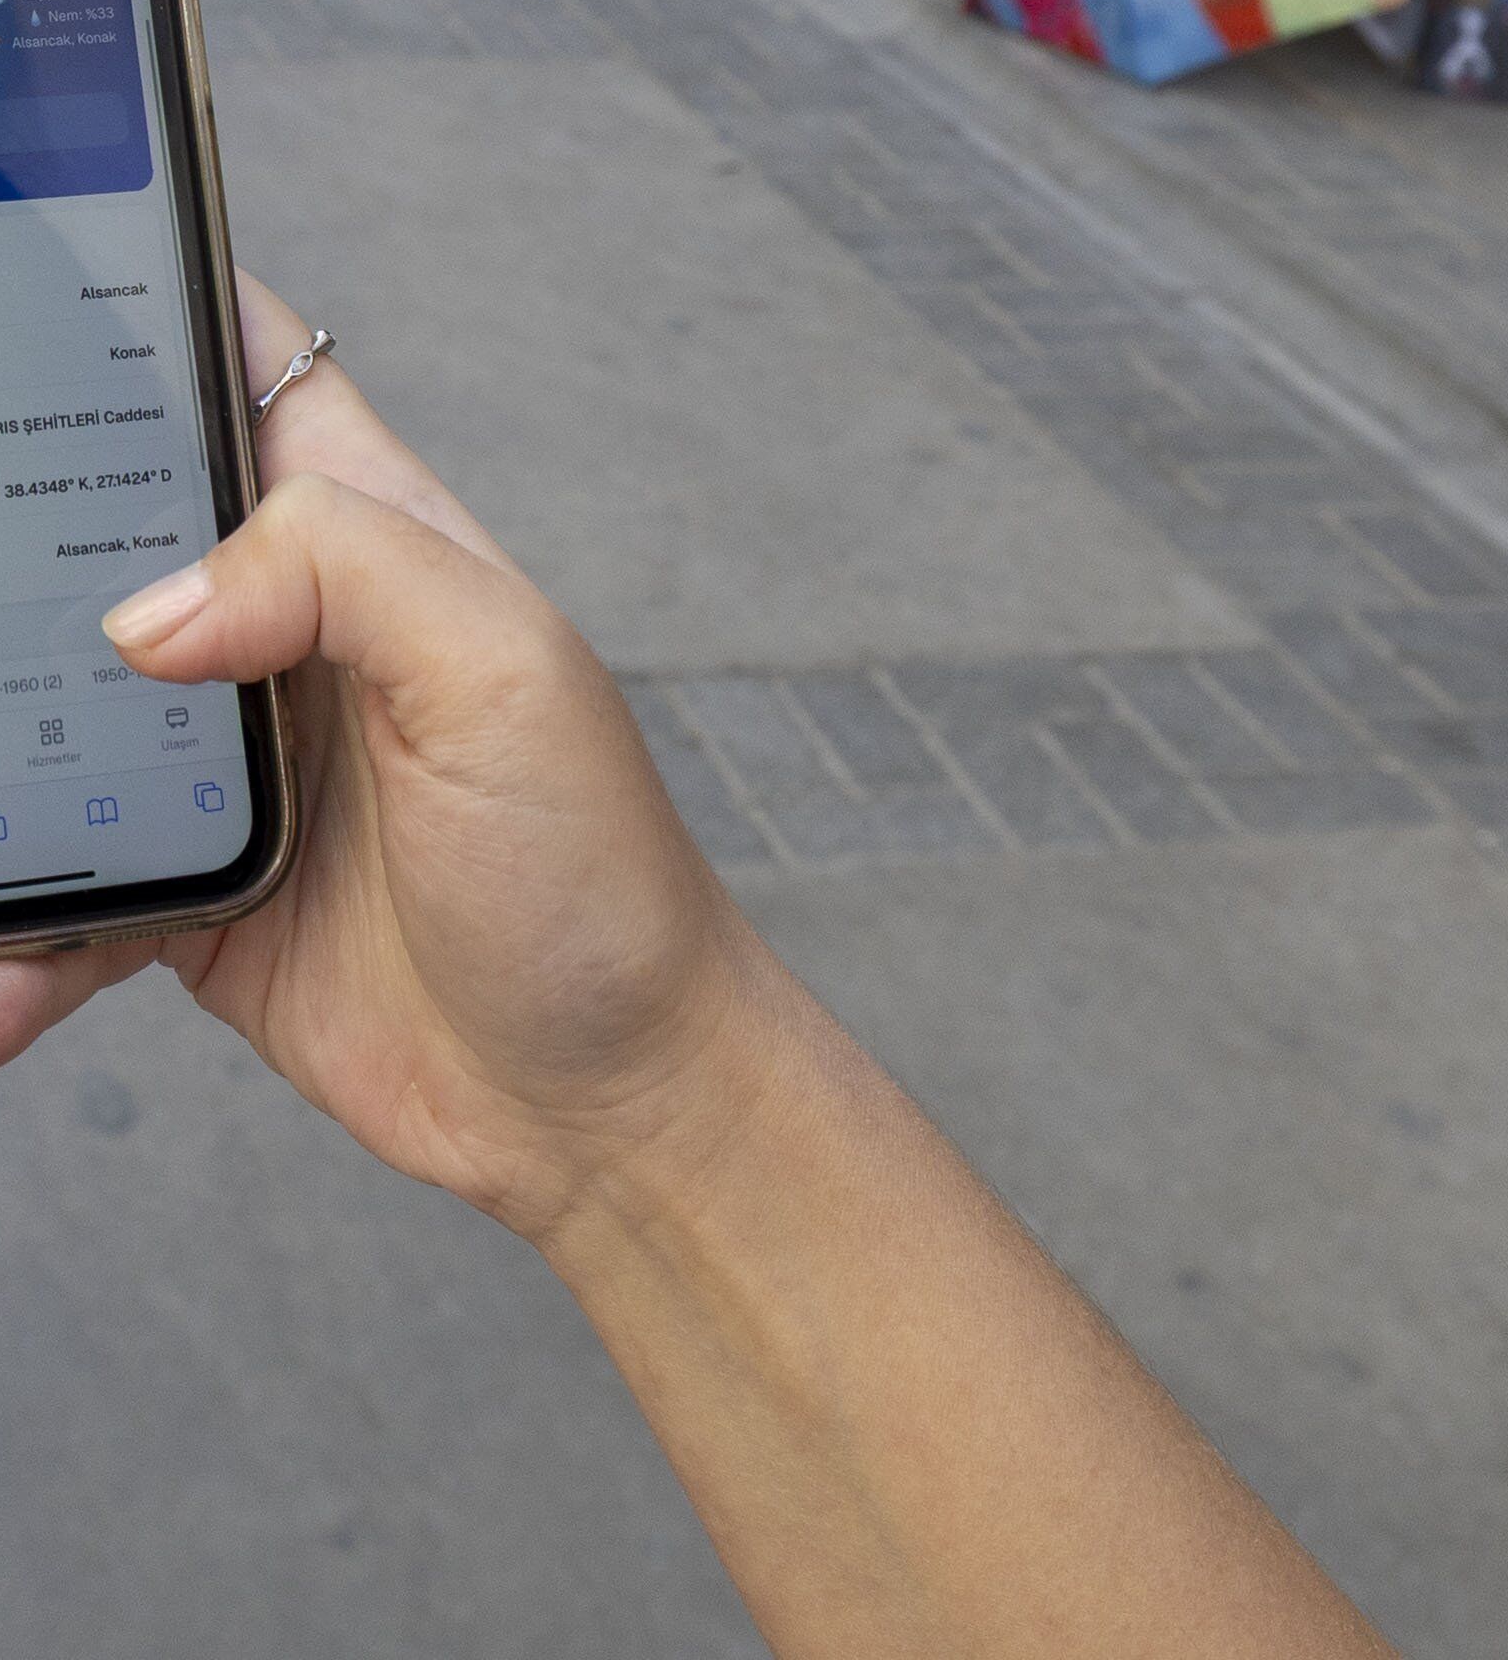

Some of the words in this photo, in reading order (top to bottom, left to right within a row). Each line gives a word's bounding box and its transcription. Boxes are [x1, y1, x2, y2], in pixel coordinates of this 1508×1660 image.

[48, 10, 83, 22] Nem:
[86, 7, 115, 21] %33
[12, 34, 75, 49] Alsancak,
[77, 31, 117, 45] Konak
[80, 282, 149, 302] Alsancak
[109, 343, 157, 361] Konak
[23, 408, 100, 436] ŞEHİTLERİ
[104, 405, 165, 425] Caddesi
[4, 478, 75, 499] 38.4348°
[78, 476, 93, 493] K,
[160, 468, 172, 483] D
[56, 537, 131, 559] Alsancak,
[132, 532, 180, 551] Konak
[43, 673, 63, 693] (2)
[27, 752, 83, 768] Hizmetler
